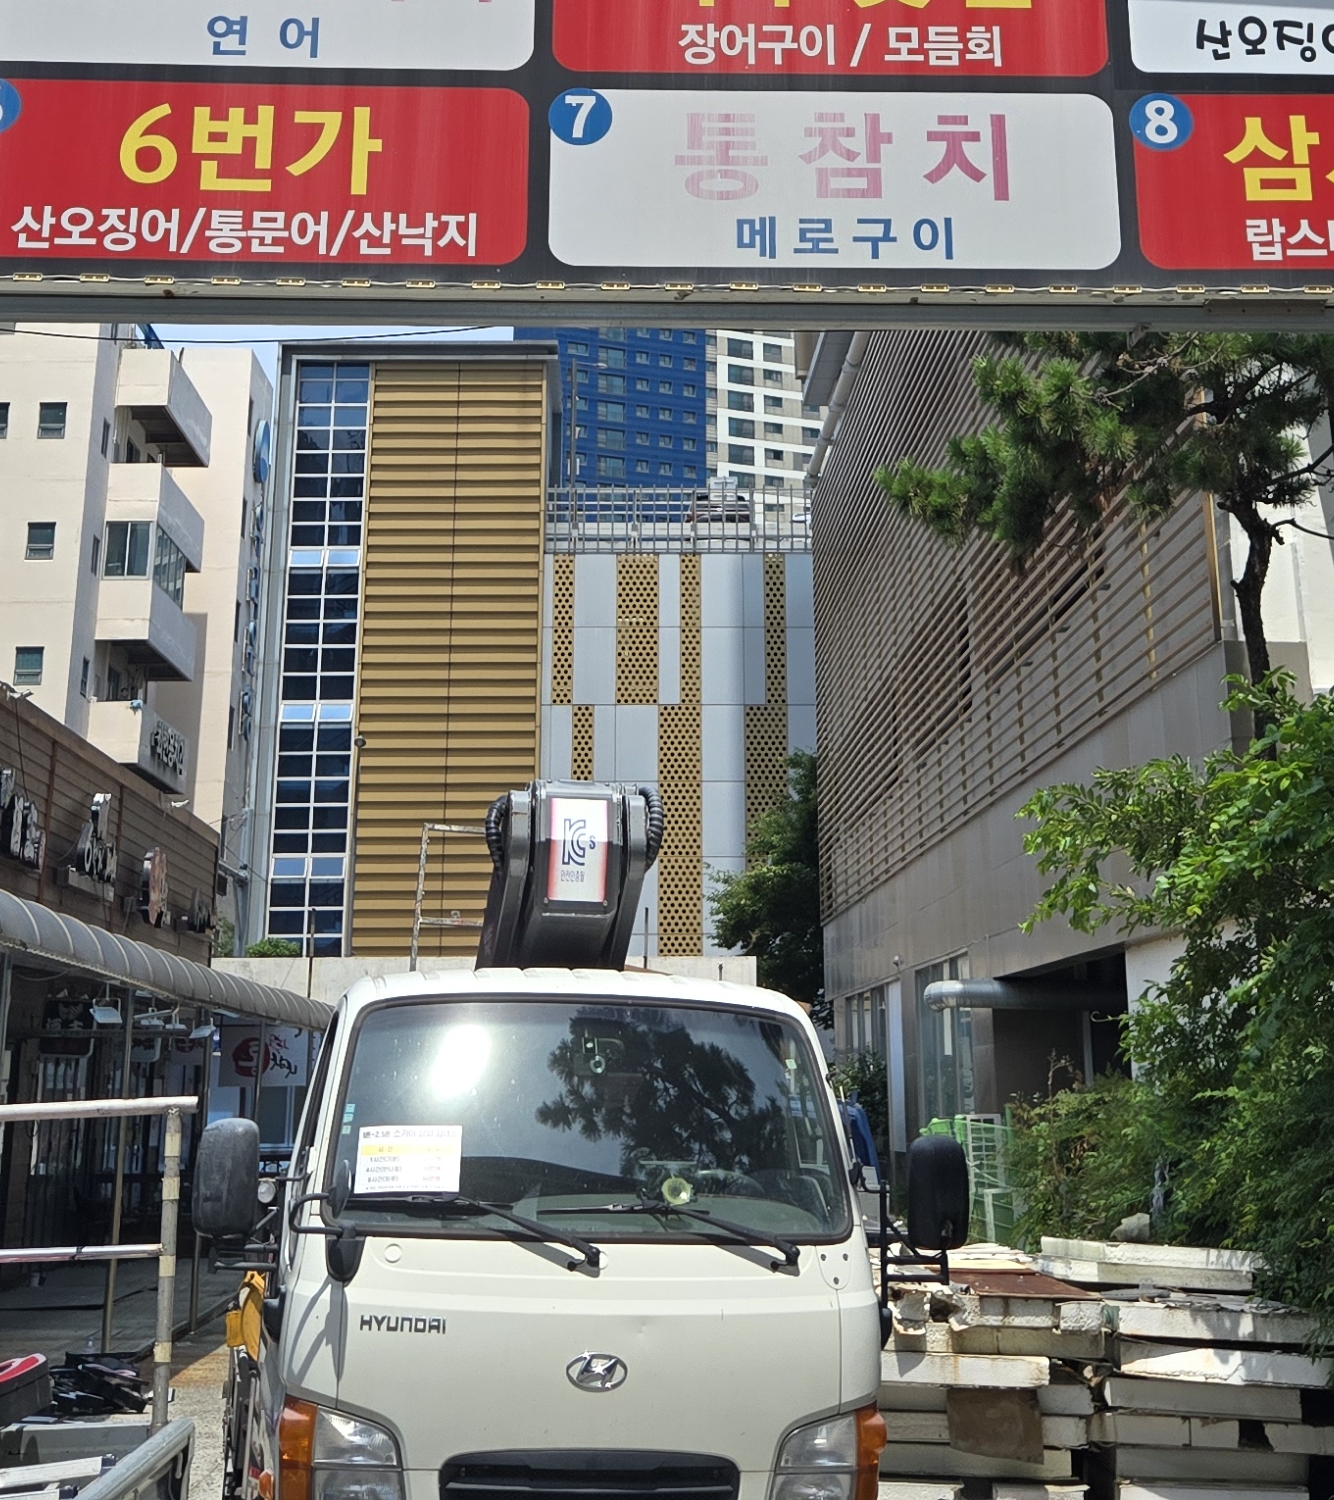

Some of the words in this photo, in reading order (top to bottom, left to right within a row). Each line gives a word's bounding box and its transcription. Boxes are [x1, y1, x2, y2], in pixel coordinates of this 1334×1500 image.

[678, 22, 836, 67] 장어구이
[884, 24, 1003, 67] 모듬회
[564, 95, 597, 139] 7
[1143, 100, 1179, 145] 8
[119, 102, 384, 196] 6번가
[674, 112, 1011, 201] 통참치
[735, 216, 955, 261] 메로구이
[359, 1314, 446, 1334] HYUNDAI
